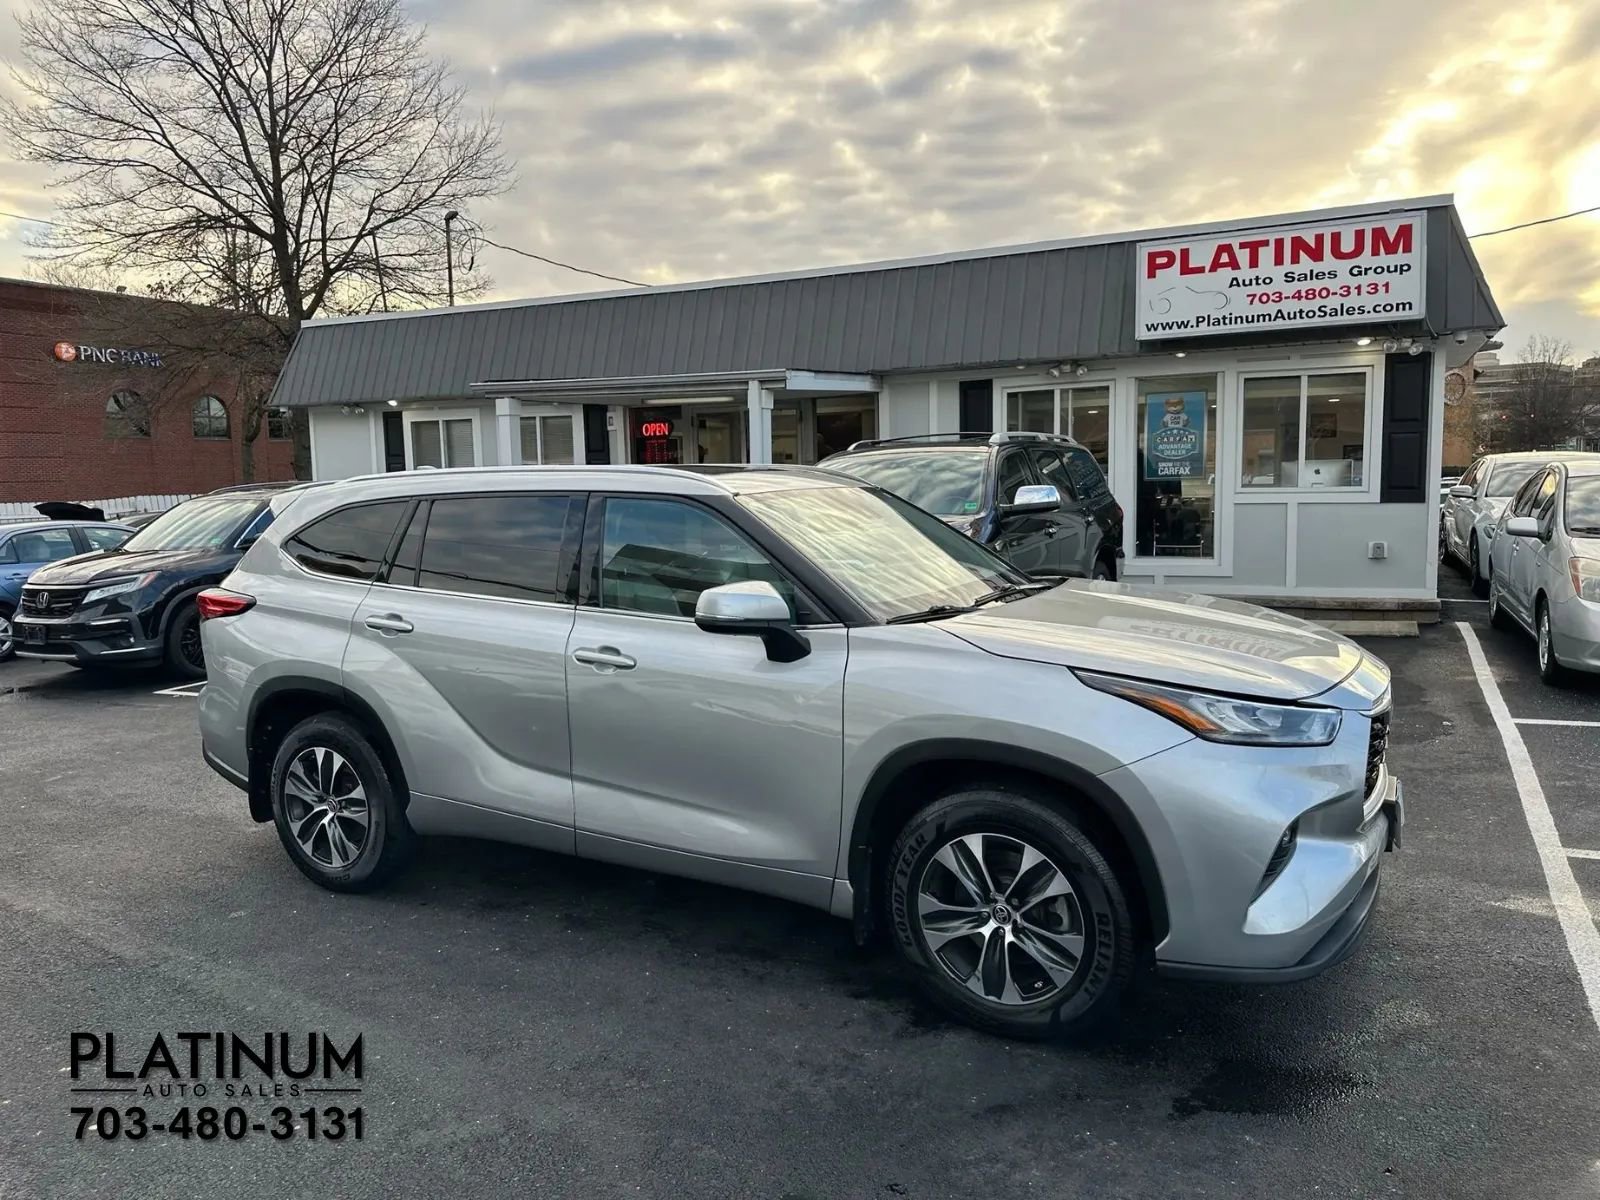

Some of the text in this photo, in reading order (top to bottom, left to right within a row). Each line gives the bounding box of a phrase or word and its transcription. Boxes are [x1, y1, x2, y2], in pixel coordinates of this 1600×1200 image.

[1146, 223, 1413, 280] PLATINUM
[1228, 261, 1412, 289] Auto Sales Group
[1246, 281, 1391, 306] 703-480-3131
[1145, 300, 1413, 333] www.PlatinumAutoSales.com
[79, 345, 117, 363] PNC
[642, 422, 669, 437] OPEN
[1158, 466, 1191, 475] CARFAX
